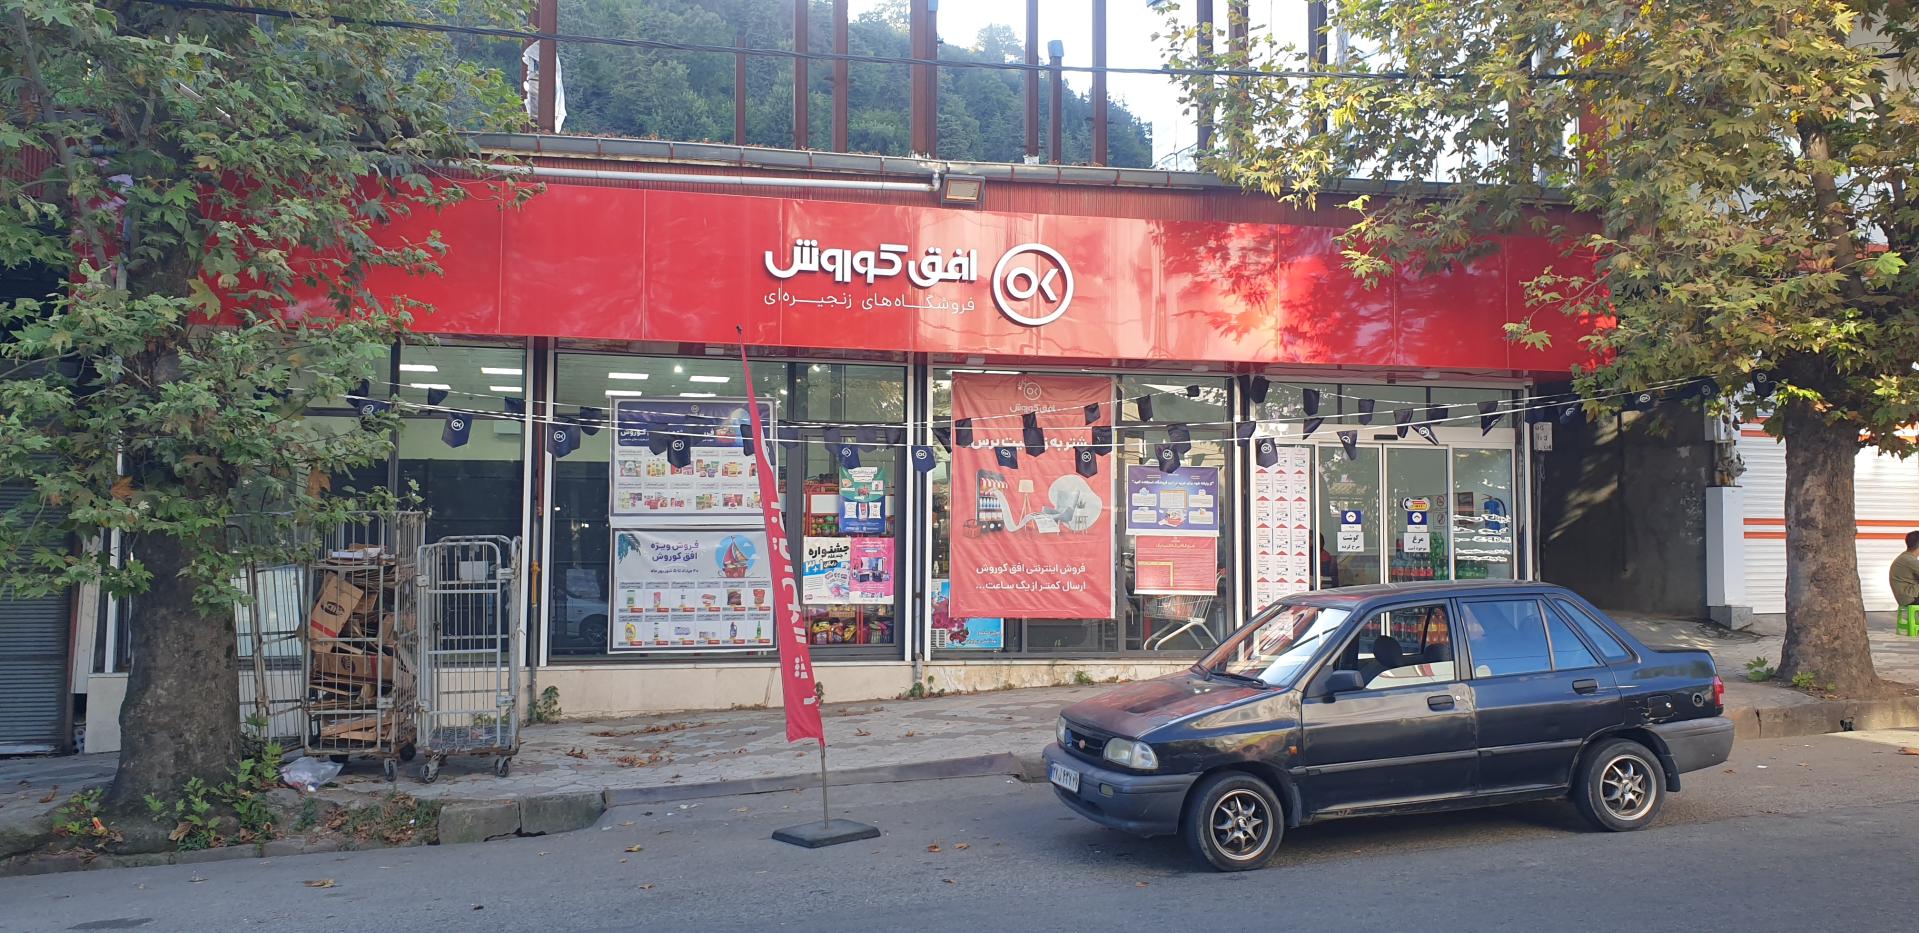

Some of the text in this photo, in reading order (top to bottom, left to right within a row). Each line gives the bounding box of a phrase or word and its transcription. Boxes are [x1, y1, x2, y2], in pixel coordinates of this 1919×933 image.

[763, 238, 978, 288] افق کوروش
[1411, 535, 1424, 544] مرغ
[650, 540, 699, 551] فروش ویژه
[808, 542, 850, 558] جشنواره
[652, 551, 698, 562] افق کوروش
[976, 562, 1086, 575] فروش اینترنتی افق کوروش
[1015, 580, 1031, 592] یک
[1030, 581, 1038, 592] از
[1039, 581, 1061, 592] کمتر
[1062, 580, 1086, 592] ارسال
